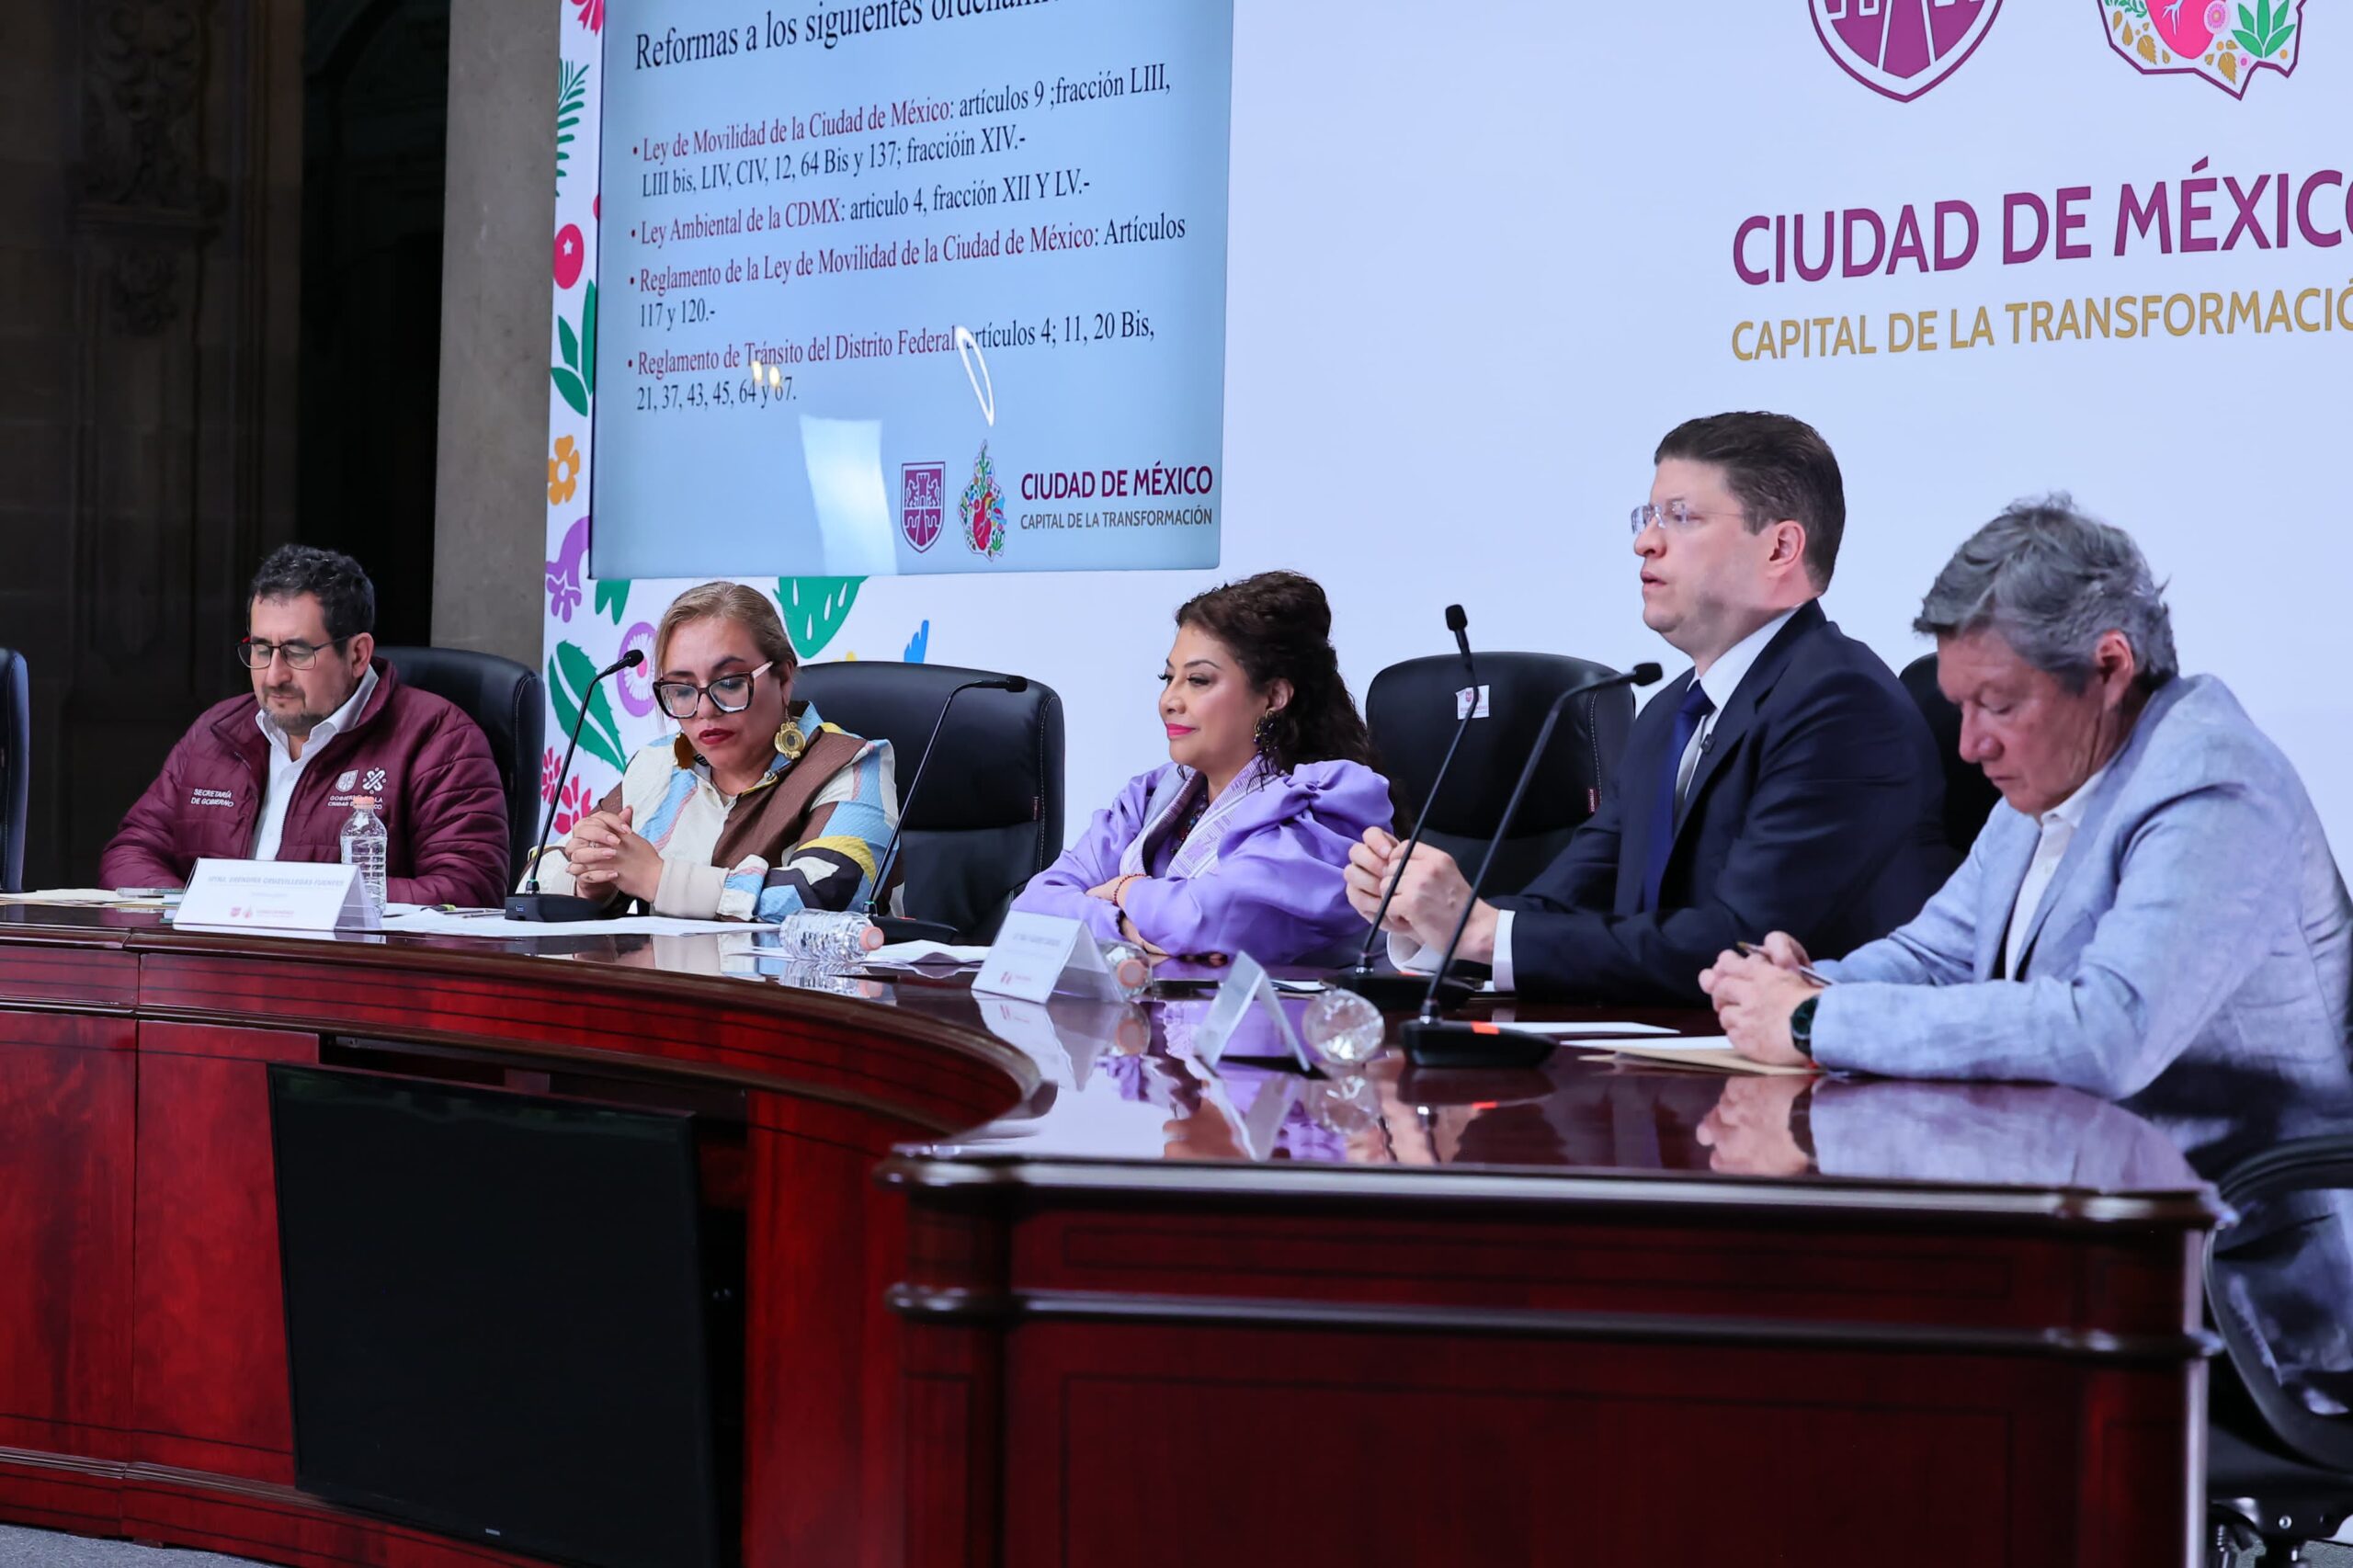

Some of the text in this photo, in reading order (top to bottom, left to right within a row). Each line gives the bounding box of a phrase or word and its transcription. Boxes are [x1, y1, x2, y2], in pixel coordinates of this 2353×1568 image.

[635, 28, 738, 70] Reformas
[746, 24, 757, 51] a
[766, 10, 797, 48] los
[805, 0, 922, 50] siguientes
[643, 63, 1170, 165] Ley de Movilidad de la Ciudad de México: artículos 9 ;fracción LIII,
[642, 124, 1026, 198] LIII bis, LIV, CIV, 12, 64 Bis y 137; fraccióin XIV.-
[642, 168, 1090, 248] Ley Ambiental de la CDMX: articulo 4, fracción XII Y LV.-
[1733, 155, 2353, 286] CIUDAD DE MÉXIC
[640, 211, 1186, 297] Reglamento de la Ley de Movilidad de la Ciudad de México: Artículos
[638, 349, 719, 380] Reglamento
[723, 344, 740, 369] de
[745, 339, 803, 367] Tránsito
[808, 335, 830, 362] del
[835, 331, 892, 359] Distrito
[1040, 317, 1056, 348] 4;
[1065, 314, 1087, 346] 11,
[1094, 312, 1115, 340] 20
[1121, 309, 1154, 341] Bis,
[641, 298, 715, 331] 117 y 120.-
[1732, 314, 1877, 361] CAPITAL
[1888, 310, 1938, 355] DE
[1950, 305, 1995, 349] LA
[636, 386, 657, 413] 21,
[662, 384, 682, 412] 37,
[687, 382, 708, 410] 43,
[712, 381, 734, 408] 45,
[739, 378, 756, 403] 64
[761, 384, 769, 409] y
[1021, 460, 1212, 500] CIUDAD DE MÉXICO
[1020, 505, 1212, 529] CAPITAL DE LA TRANSFORMACIÓN
[193, 788, 233, 799] SECRETARÍA
[201, 798, 234, 807] GOBIERNO
